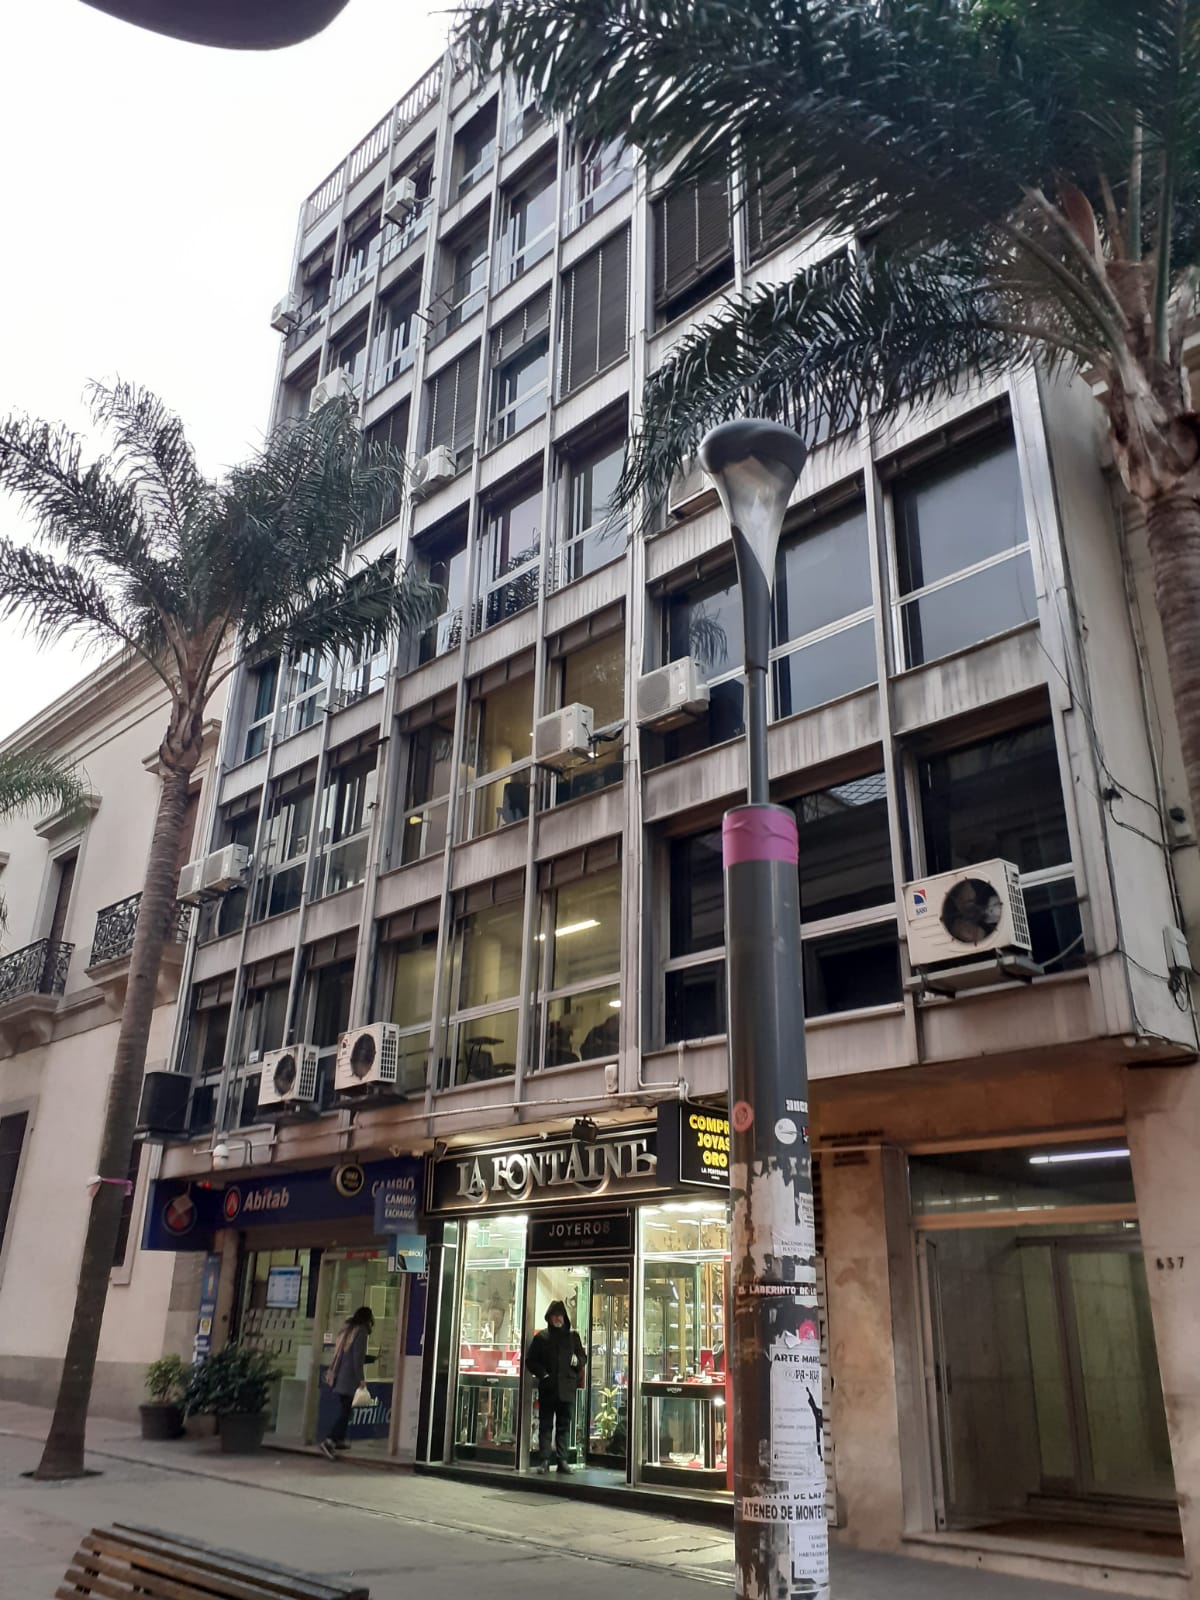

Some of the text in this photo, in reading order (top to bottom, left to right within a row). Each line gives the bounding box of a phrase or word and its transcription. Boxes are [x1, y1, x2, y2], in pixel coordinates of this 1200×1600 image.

[697, 1132, 730, 1151] JOYAS
[702, 1150, 728, 1168] ORO
[456, 1139, 658, 1204] LA FONTAINE
[242, 1186, 290, 1212] Abitab
[385, 1194, 417, 1205] CAMBIO
[749, 1284, 797, 1296] LABERINTO
[774, 1353, 800, 1363] ARTE
[744, 1501, 778, 1520] ATENEO
[781, 1505, 793, 1520] DE
